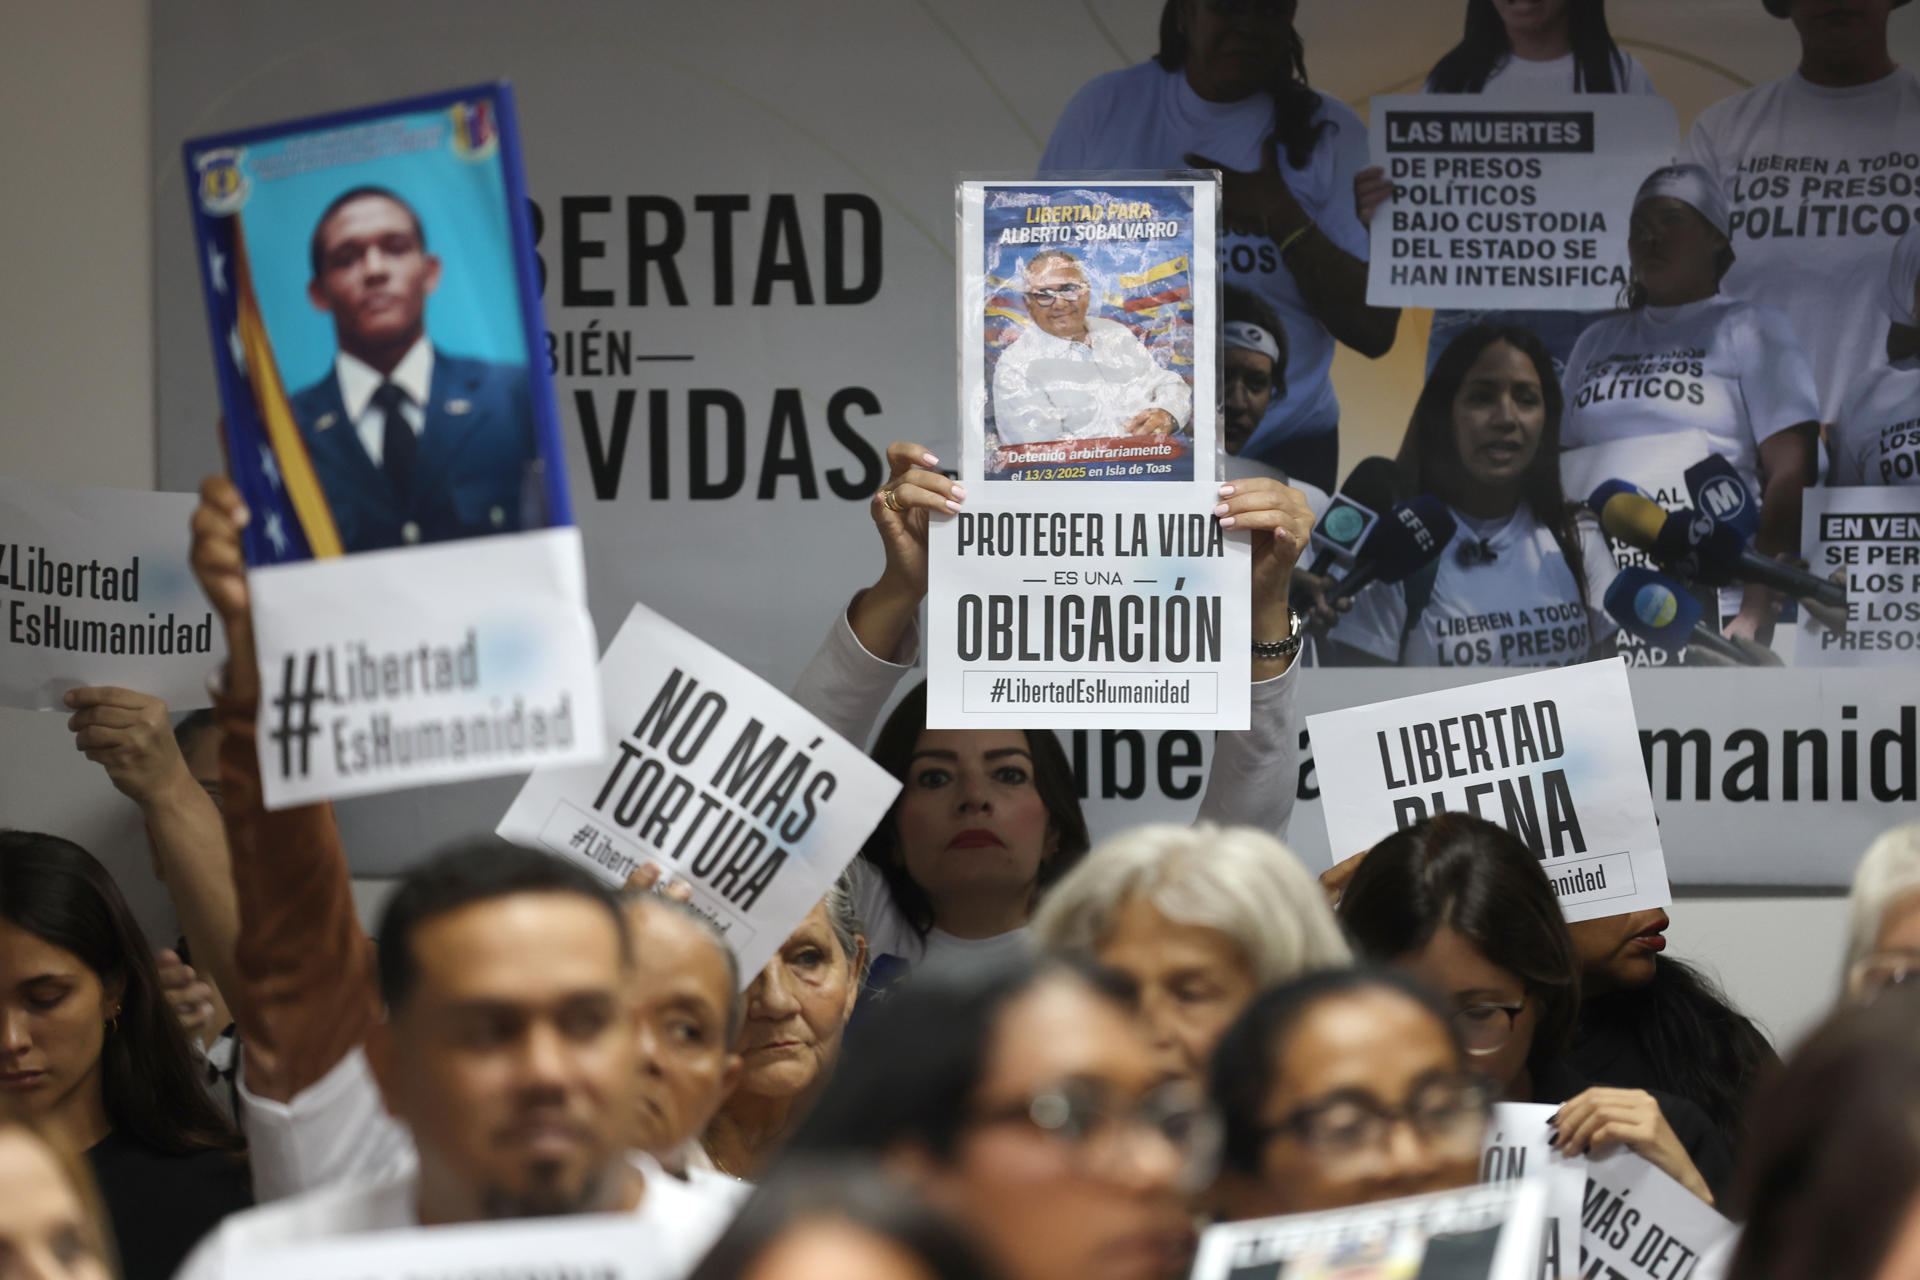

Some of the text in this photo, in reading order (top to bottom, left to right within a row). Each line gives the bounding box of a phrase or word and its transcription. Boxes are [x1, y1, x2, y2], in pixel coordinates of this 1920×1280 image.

[1390, 121, 1580, 144] LAS MUERTES
[1391, 158, 1541, 179] DE PRESOS
[1835, 160, 1850, 173] A
[1392, 180, 1537, 205] POLÍTICOS
[1734, 175, 1790, 204] LOS
[1026, 202, 1152, 223] LIBERTAD PARA
[1392, 211, 1607, 232] BAJO CUSTODIA
[1000, 221, 1178, 244] ALBERTO SOBALVARRO
[1391, 238, 1598, 259] DEL ESTADO SE
[1390, 265, 1447, 286] HAN
[573, 386, 884, 502] VIDAS
[1009, 443, 1171, 464] Detenido arbitrariamente
[1011, 462, 1172, 481] el 13/3/2025 en Isla de Toas
[957, 511, 1224, 558] PROTEGER LA VIDA
[1827, 517, 1862, 539] EN
[1825, 546, 1859, 566] SE
[1054, 571, 1123, 585] ES UNA
[1850, 573, 1904, 593] LOS
[957, 577, 1222, 664] OBLIGACIÓN
[1867, 602, 1920, 621] LOS
[9, 600, 212, 655] EsHumanidad
[1436, 611, 1514, 638] LIBEREN
[1519, 610, 1533, 627] A
[1437, 638, 1492, 667] LOS
[1821, 631, 1920, 651] PRESO
[990, 679, 1190, 704] #LibertadEsHumanidad
[333, 692, 576, 775] EsHumanidad
[1377, 700, 1565, 790] LIBERTAD
[633, 667, 837, 845] NO MÁS
[593, 740, 789, 913] TORTURA
